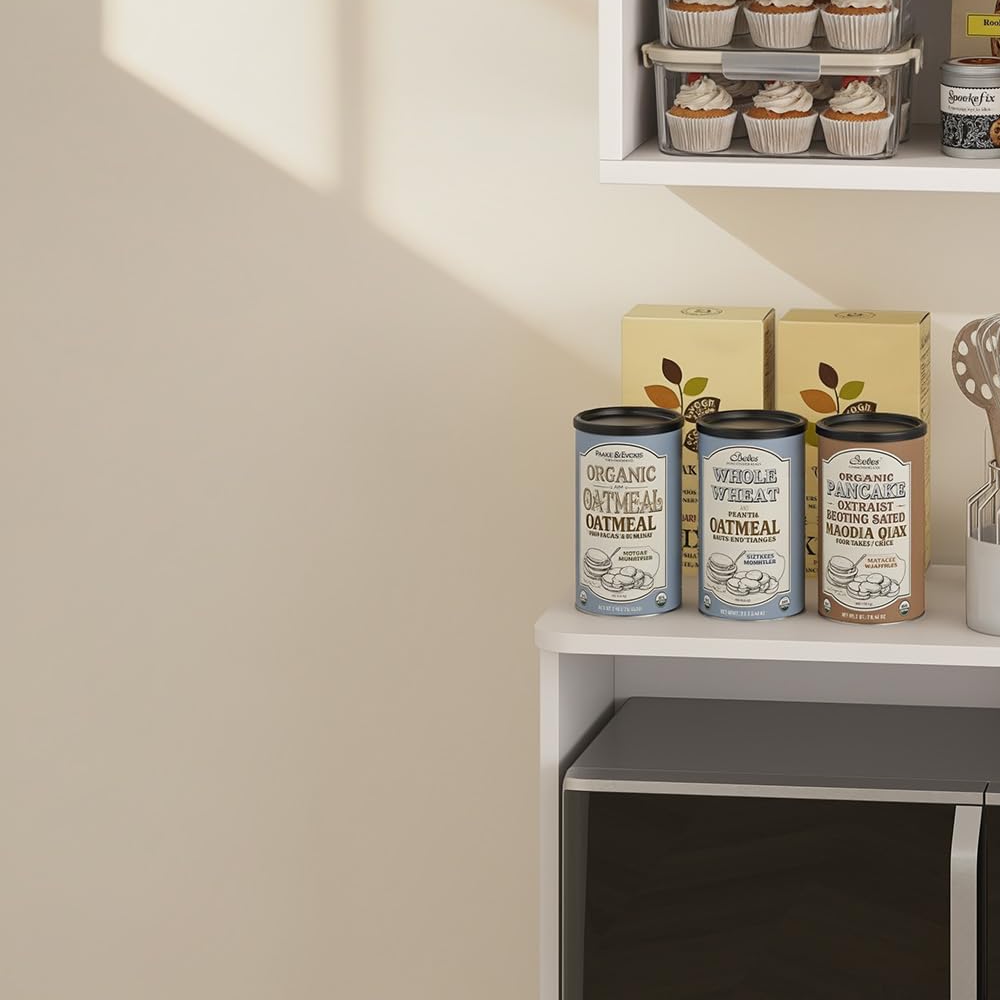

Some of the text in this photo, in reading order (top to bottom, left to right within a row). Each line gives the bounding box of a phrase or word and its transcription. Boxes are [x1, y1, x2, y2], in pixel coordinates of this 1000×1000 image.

[586, 464, 656, 483] ORGANIC
[712, 466, 778, 485] WHOLE
[839, 472, 894, 482] ORGANIC
[710, 484, 780, 503] WHEAT
[826, 479, 906, 500] PANCAKE
[583, 487, 663, 514] OATMEAL
[837, 500, 894, 512] OXTRAIST
[586, 513, 657, 533] OATMEAL
[709, 517, 781, 536] OATMEAL
[871, 511, 906, 525] SATED
